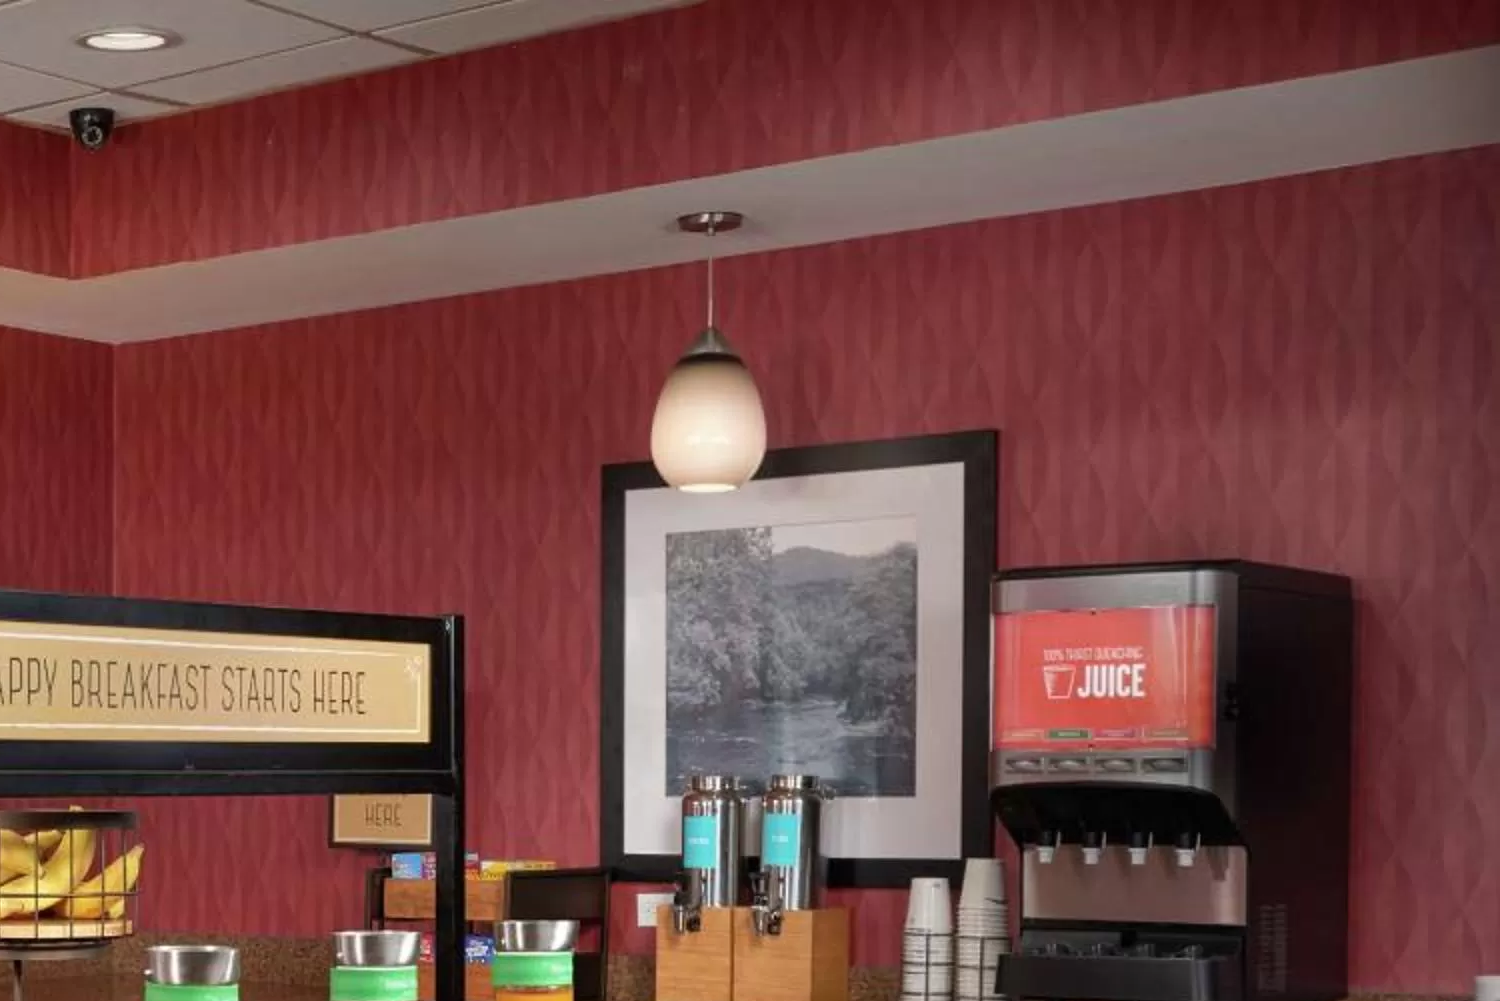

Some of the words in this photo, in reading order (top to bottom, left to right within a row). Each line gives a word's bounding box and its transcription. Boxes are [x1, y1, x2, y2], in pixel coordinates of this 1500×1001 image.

[70, 658, 212, 711] BREAKFAST
[220, 665, 302, 713] STARTS
[312, 670, 367, 715] HERE
[1077, 663, 1147, 698] JUICE
[364, 803, 403, 827] HERE
